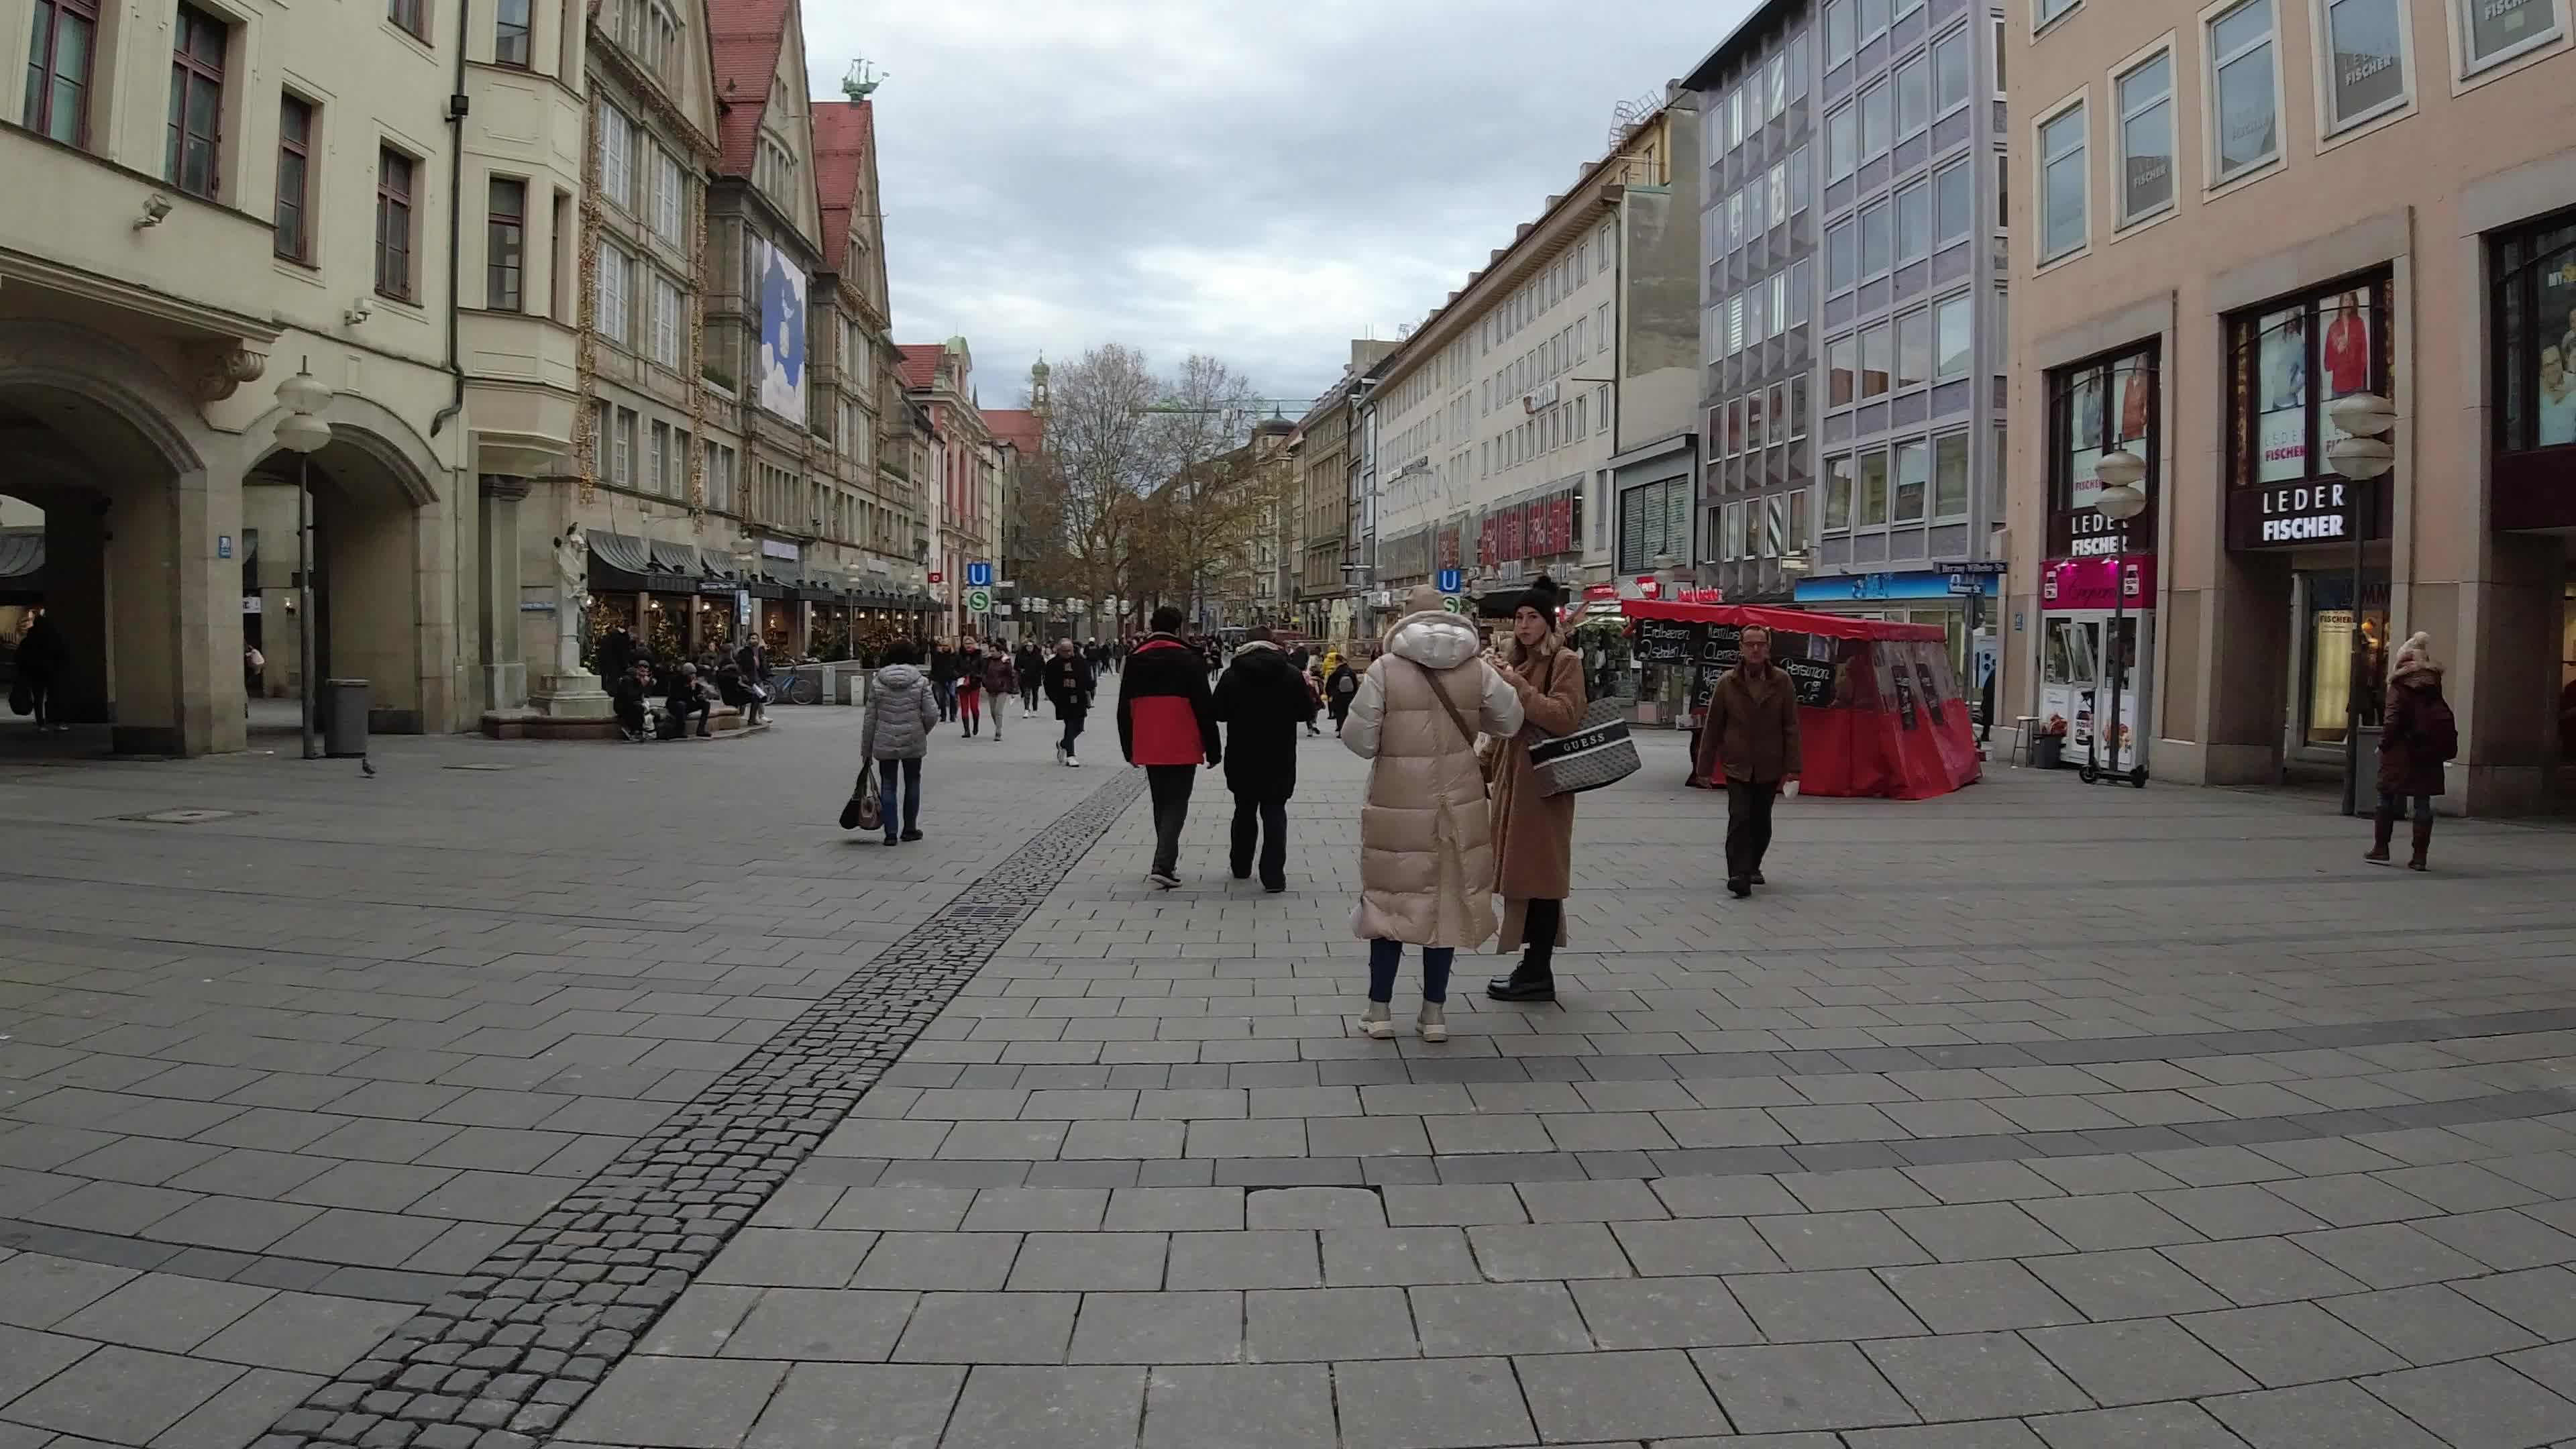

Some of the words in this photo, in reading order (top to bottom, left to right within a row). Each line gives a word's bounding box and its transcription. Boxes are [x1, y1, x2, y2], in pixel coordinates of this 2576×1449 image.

[2345, 53, 2394, 86] FISCHER
[2263, 484, 2345, 514] LEDER
[2263, 515, 2345, 541] FISCHER
[971, 565, 986, 584] U
[1443, 571, 1457, 590] U
[973, 593, 985, 609] S
[1642, 620, 1690, 640] Erdbeeren
[1563, 733, 1605, 751] GUESS
